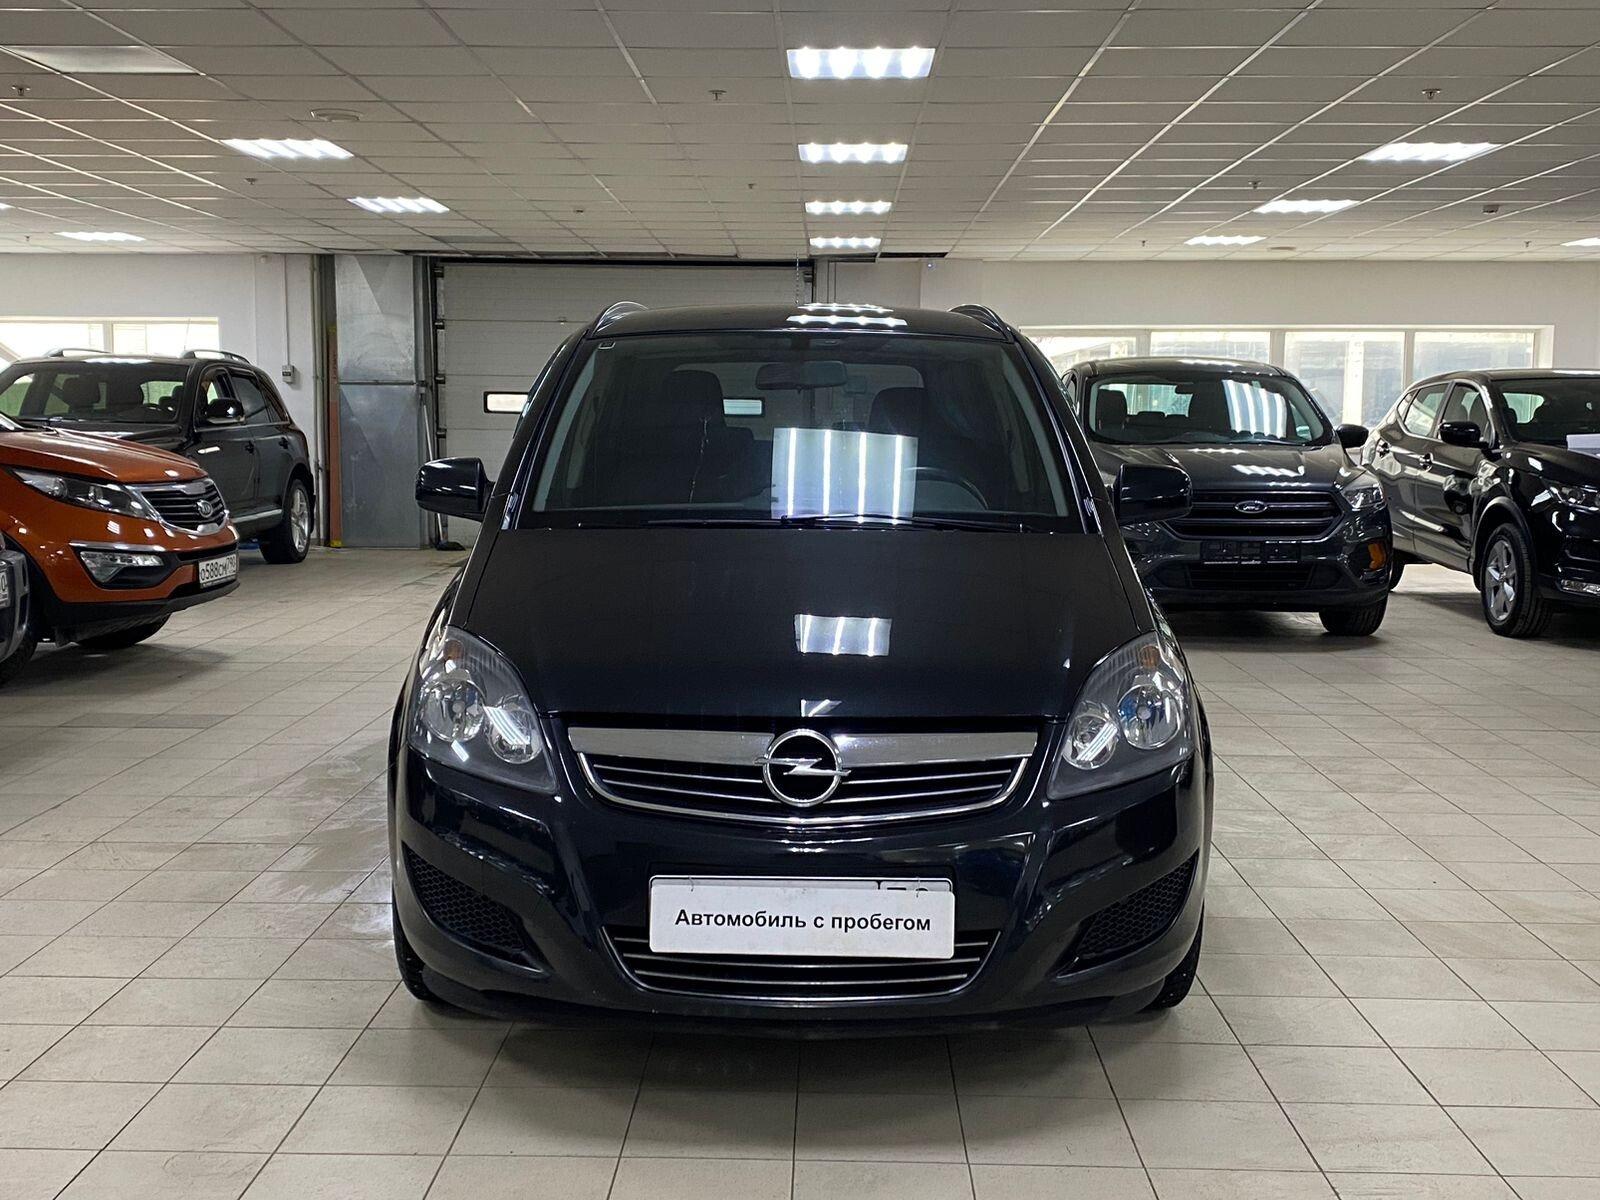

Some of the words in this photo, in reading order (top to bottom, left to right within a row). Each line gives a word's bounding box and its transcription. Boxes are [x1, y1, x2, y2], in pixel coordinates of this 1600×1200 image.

[675, 909, 807, 928] Автомобиль
[813, 916, 825, 928] с
[831, 914, 931, 932] пробегом
